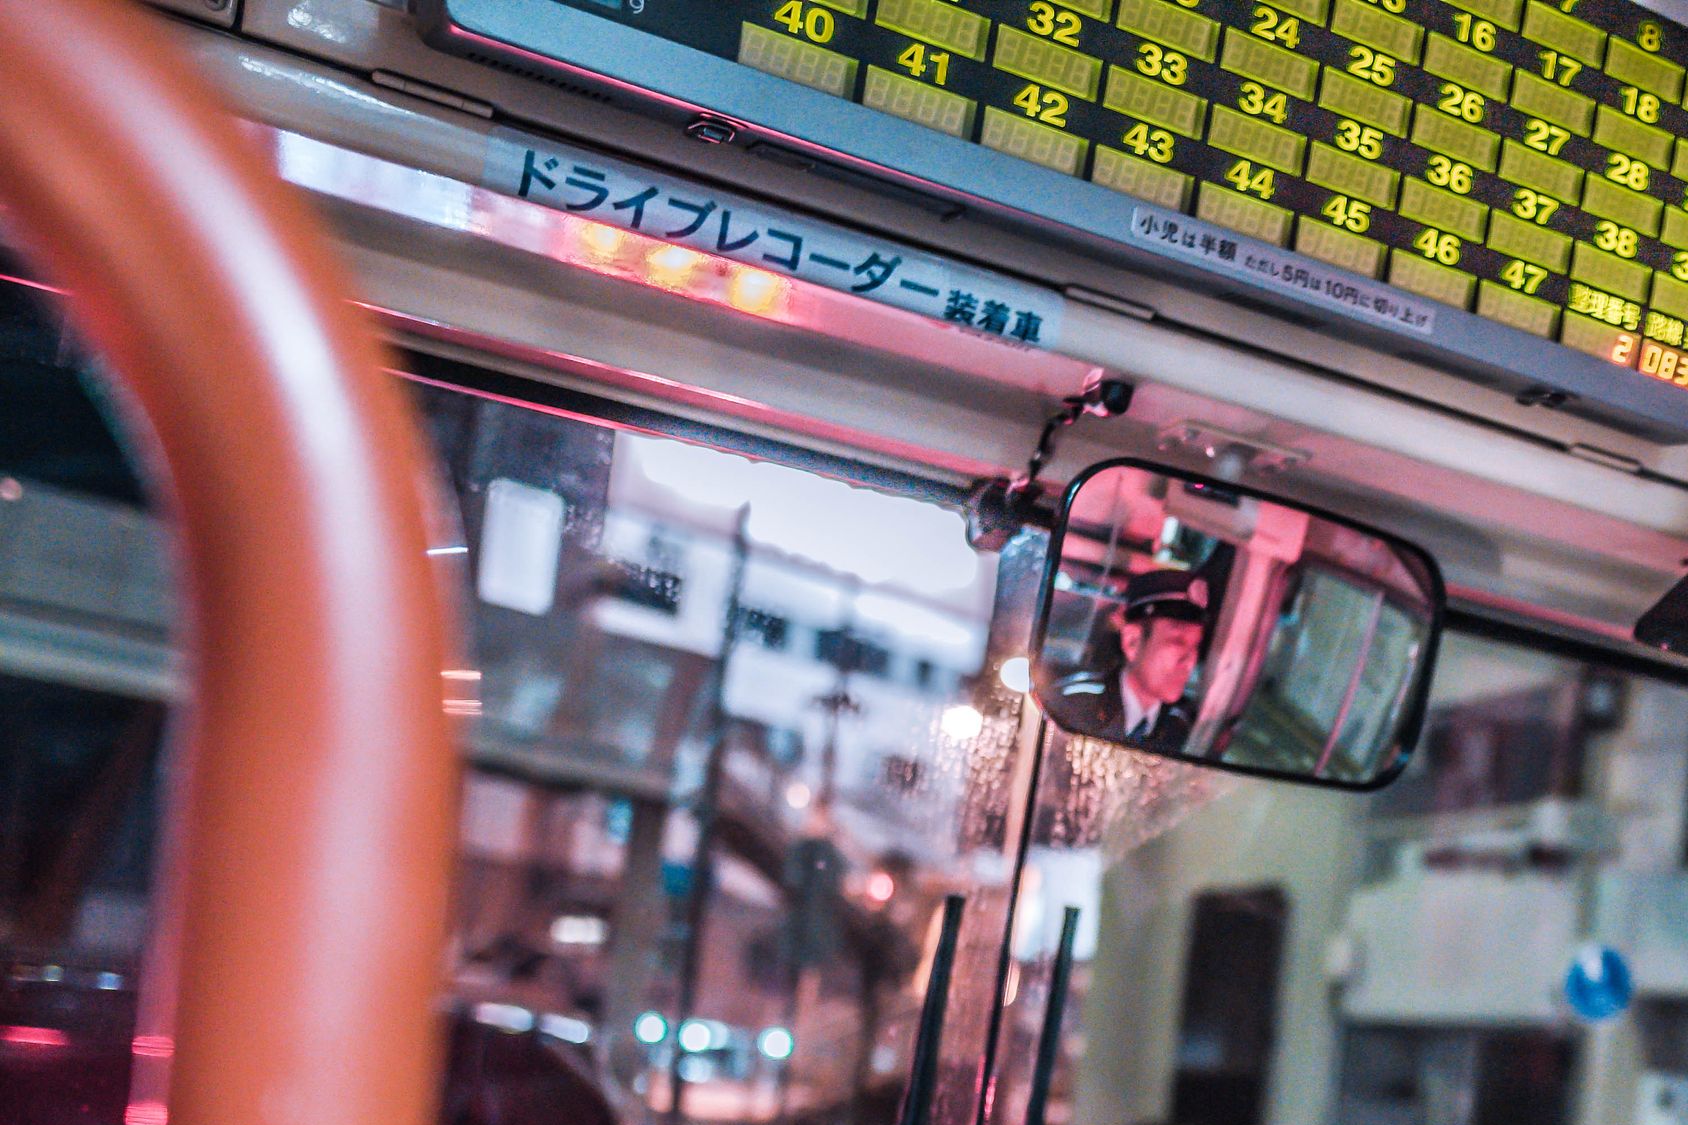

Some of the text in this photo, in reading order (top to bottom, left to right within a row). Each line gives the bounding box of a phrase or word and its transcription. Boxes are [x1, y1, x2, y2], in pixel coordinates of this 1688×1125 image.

[1251, 6, 1300, 49] 24
[1347, 45, 1395, 86] 25
[1438, 82, 1485, 123] 26
[1524, 118, 1571, 156] 27
[1604, 153, 1649, 191] 28
[1453, 12, 1497, 52] 16
[1538, 50, 1582, 87] 17
[1620, 86, 1660, 123] 18
[1636, 20, 1662, 52] 8
[774, 0, 1548, 294] 40 41 42 43 44 45 46 47
[1027, 1, 1082, 47] 32
[1136, 43, 1188, 85] 33
[1239, 82, 1287, 124] 34
[1335, 119, 1384, 160] 35
[1425, 154, 1473, 194] 36
[1512, 188, 1559, 225] 37
[1595, 220, 1638, 258] 38
[1611, 334, 1634, 363] 2
